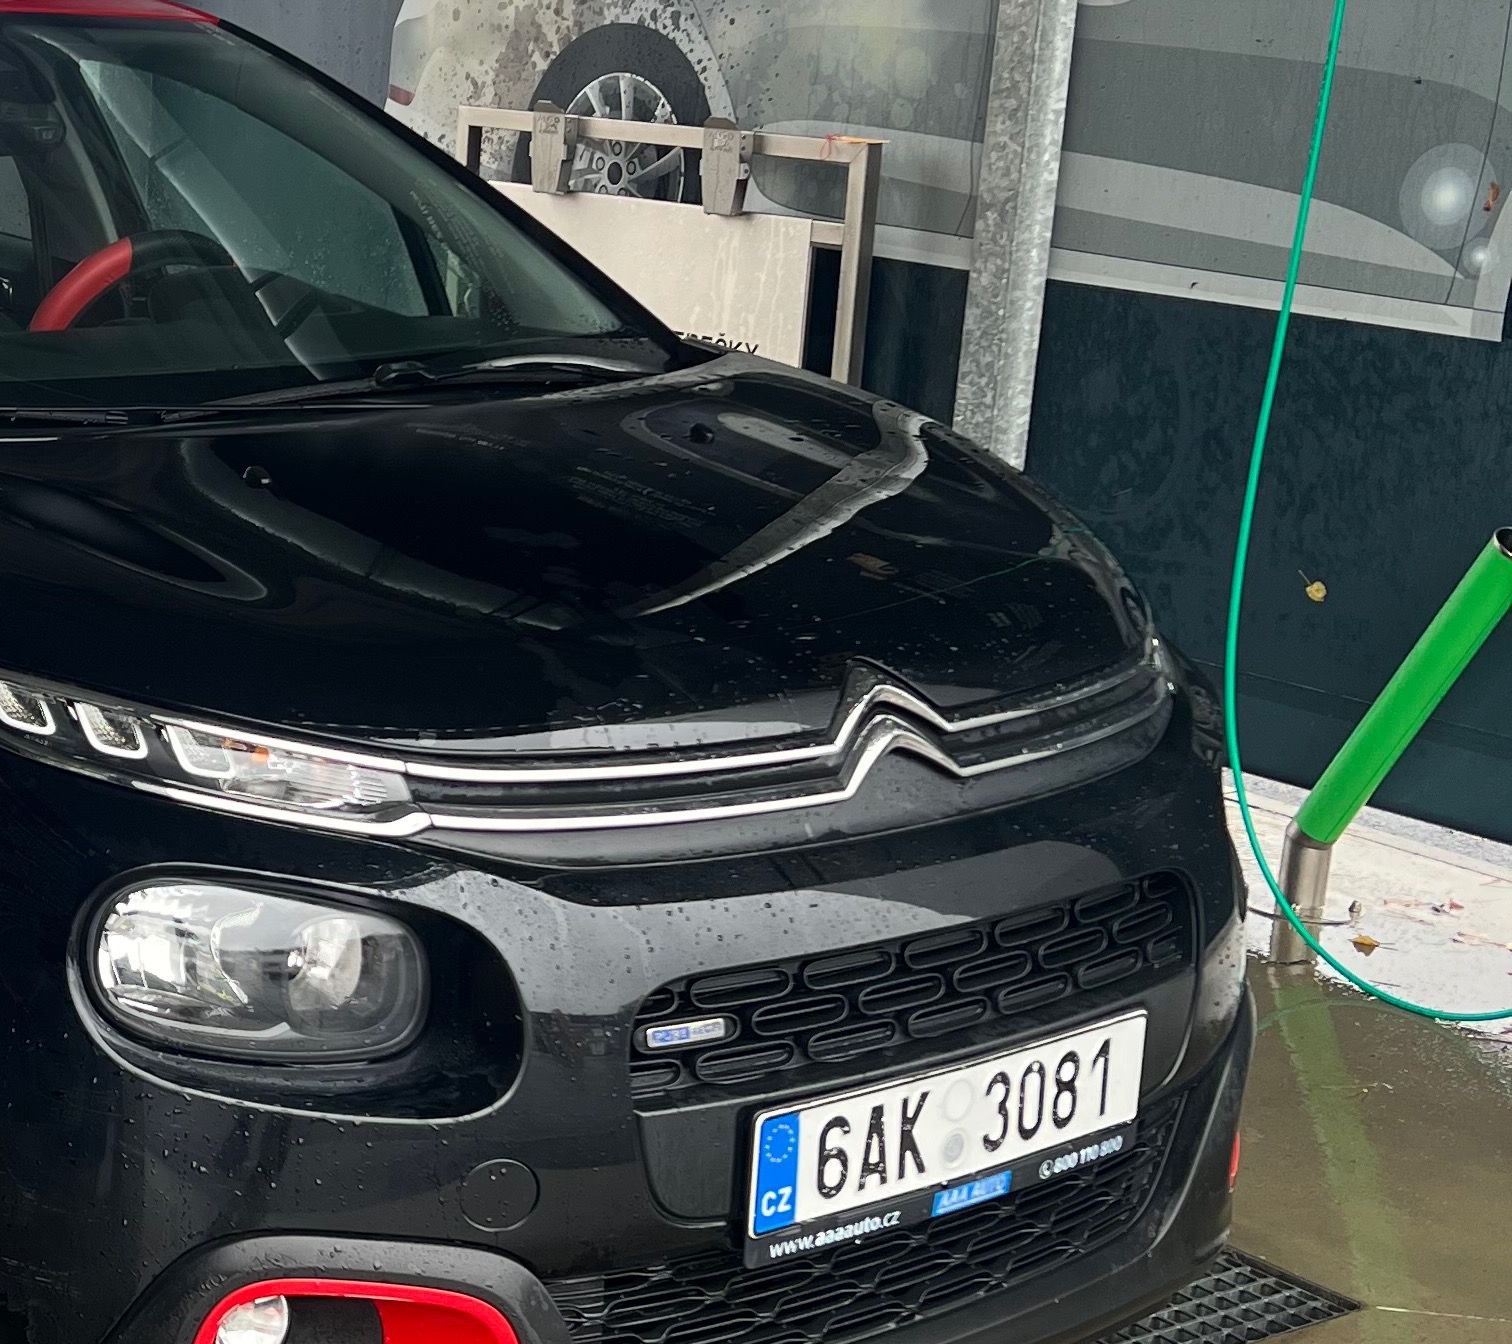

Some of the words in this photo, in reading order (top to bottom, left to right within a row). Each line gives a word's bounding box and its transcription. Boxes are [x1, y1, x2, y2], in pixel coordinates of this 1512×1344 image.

[817, 1090, 931, 1199] 6AK
[982, 1037, 1113, 1152] 3081
[761, 1186, 792, 1217] CZ
[769, 1210, 901, 1258] www.aaaauto.cz
